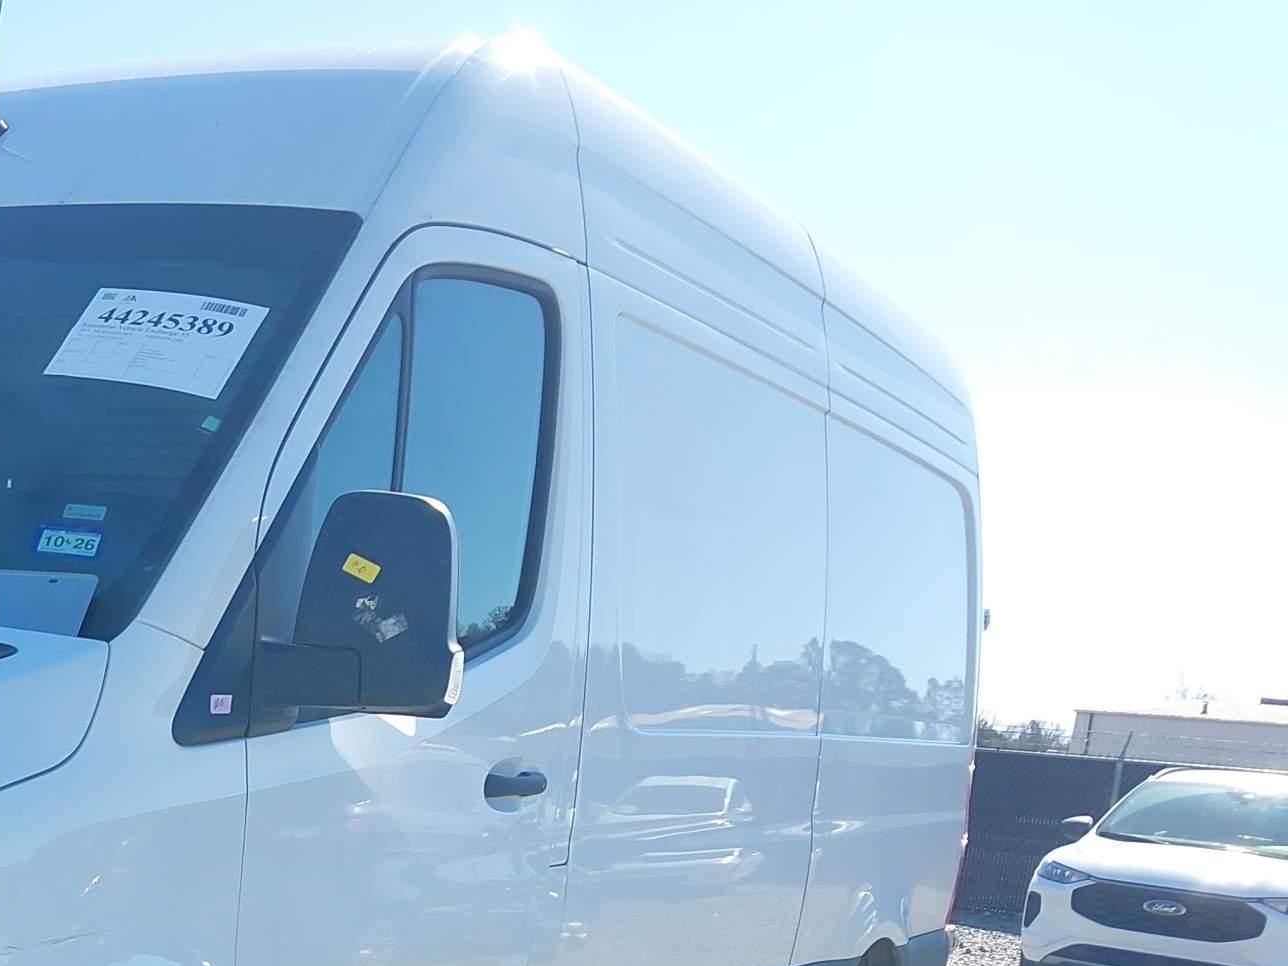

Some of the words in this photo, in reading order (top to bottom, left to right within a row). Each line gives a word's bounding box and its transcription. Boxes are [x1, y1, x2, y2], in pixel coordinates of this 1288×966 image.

[98, 307, 234, 338] 44245389
[44, 535, 65, 548] 10
[73, 537, 96, 551] 26
